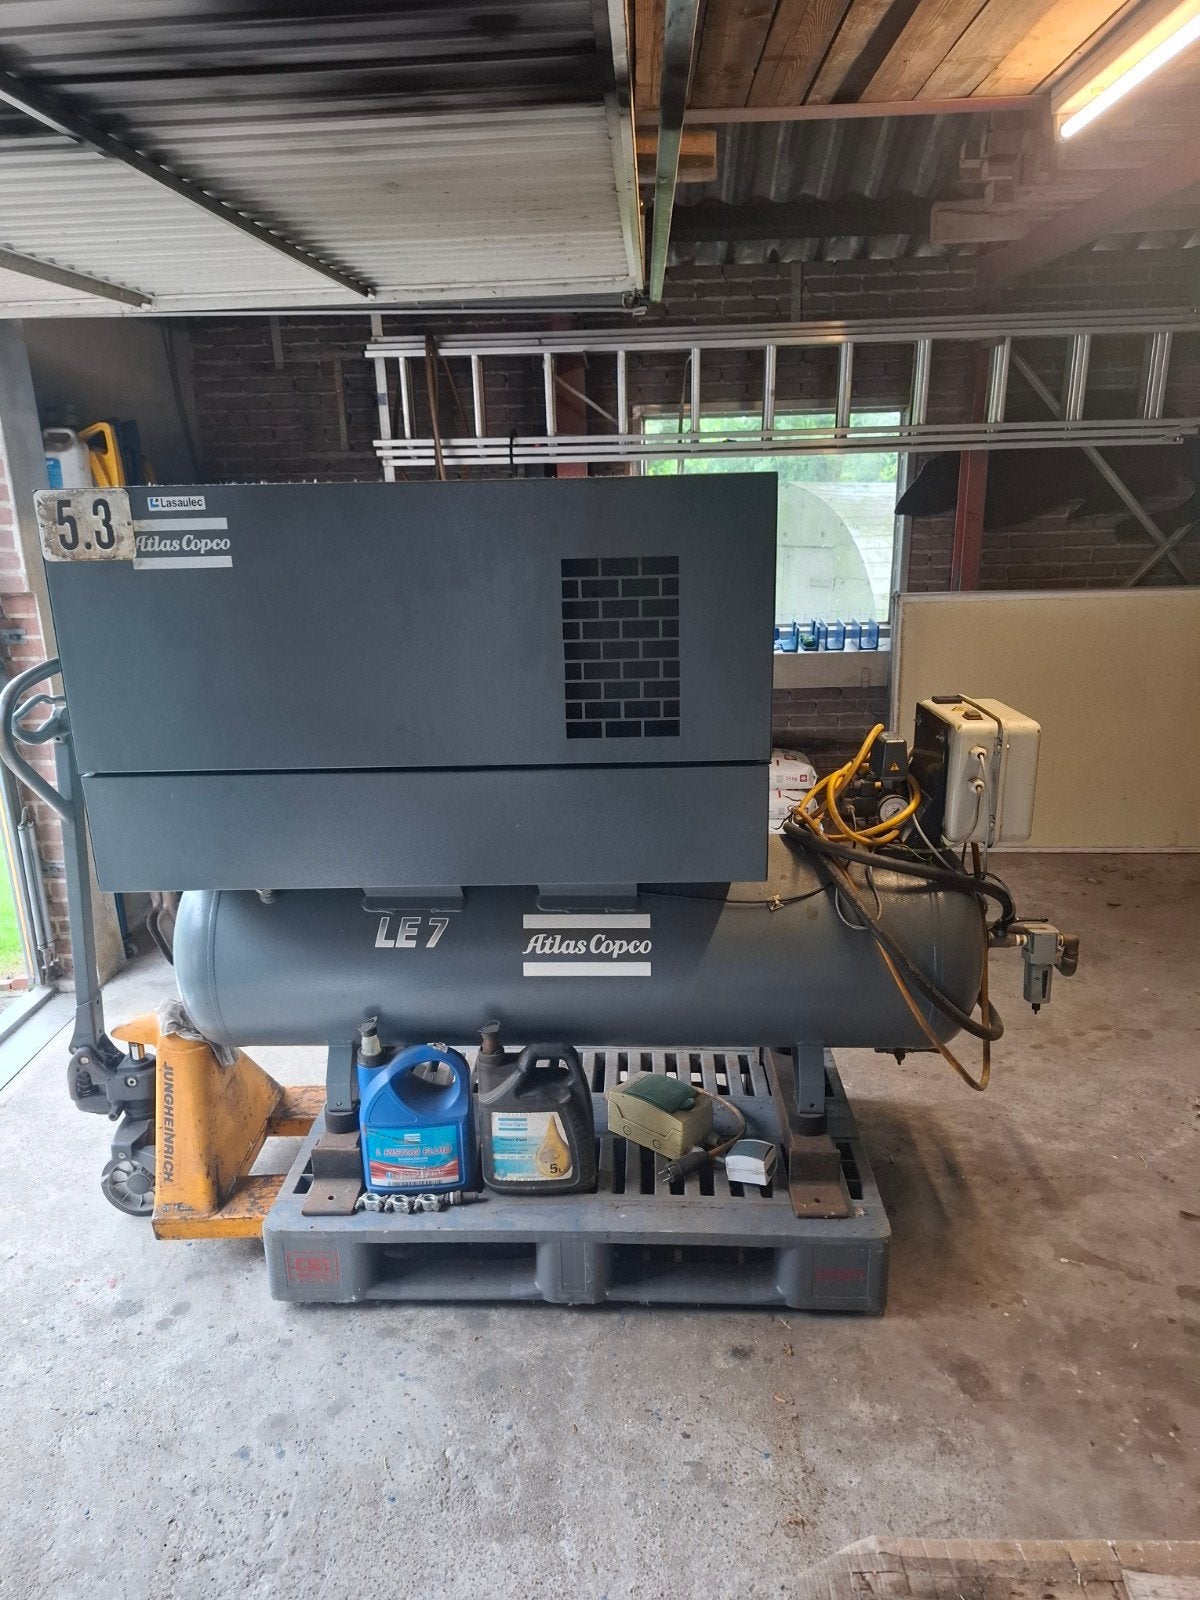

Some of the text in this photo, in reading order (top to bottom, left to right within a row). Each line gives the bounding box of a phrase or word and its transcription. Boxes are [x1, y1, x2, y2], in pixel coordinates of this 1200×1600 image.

[161, 498, 204, 508] Lasaulec
[56, 498, 116, 551] 5.3
[135, 534, 231, 554] Atlas Copco
[374, 916, 450, 948] LE 7
[522, 933, 652, 958] Atlas Copco
[163, 1061, 174, 1184] JUNGHEINRICH
[383, 1147, 421, 1157] PISTON
[421, 1145, 453, 1155] FLUID
